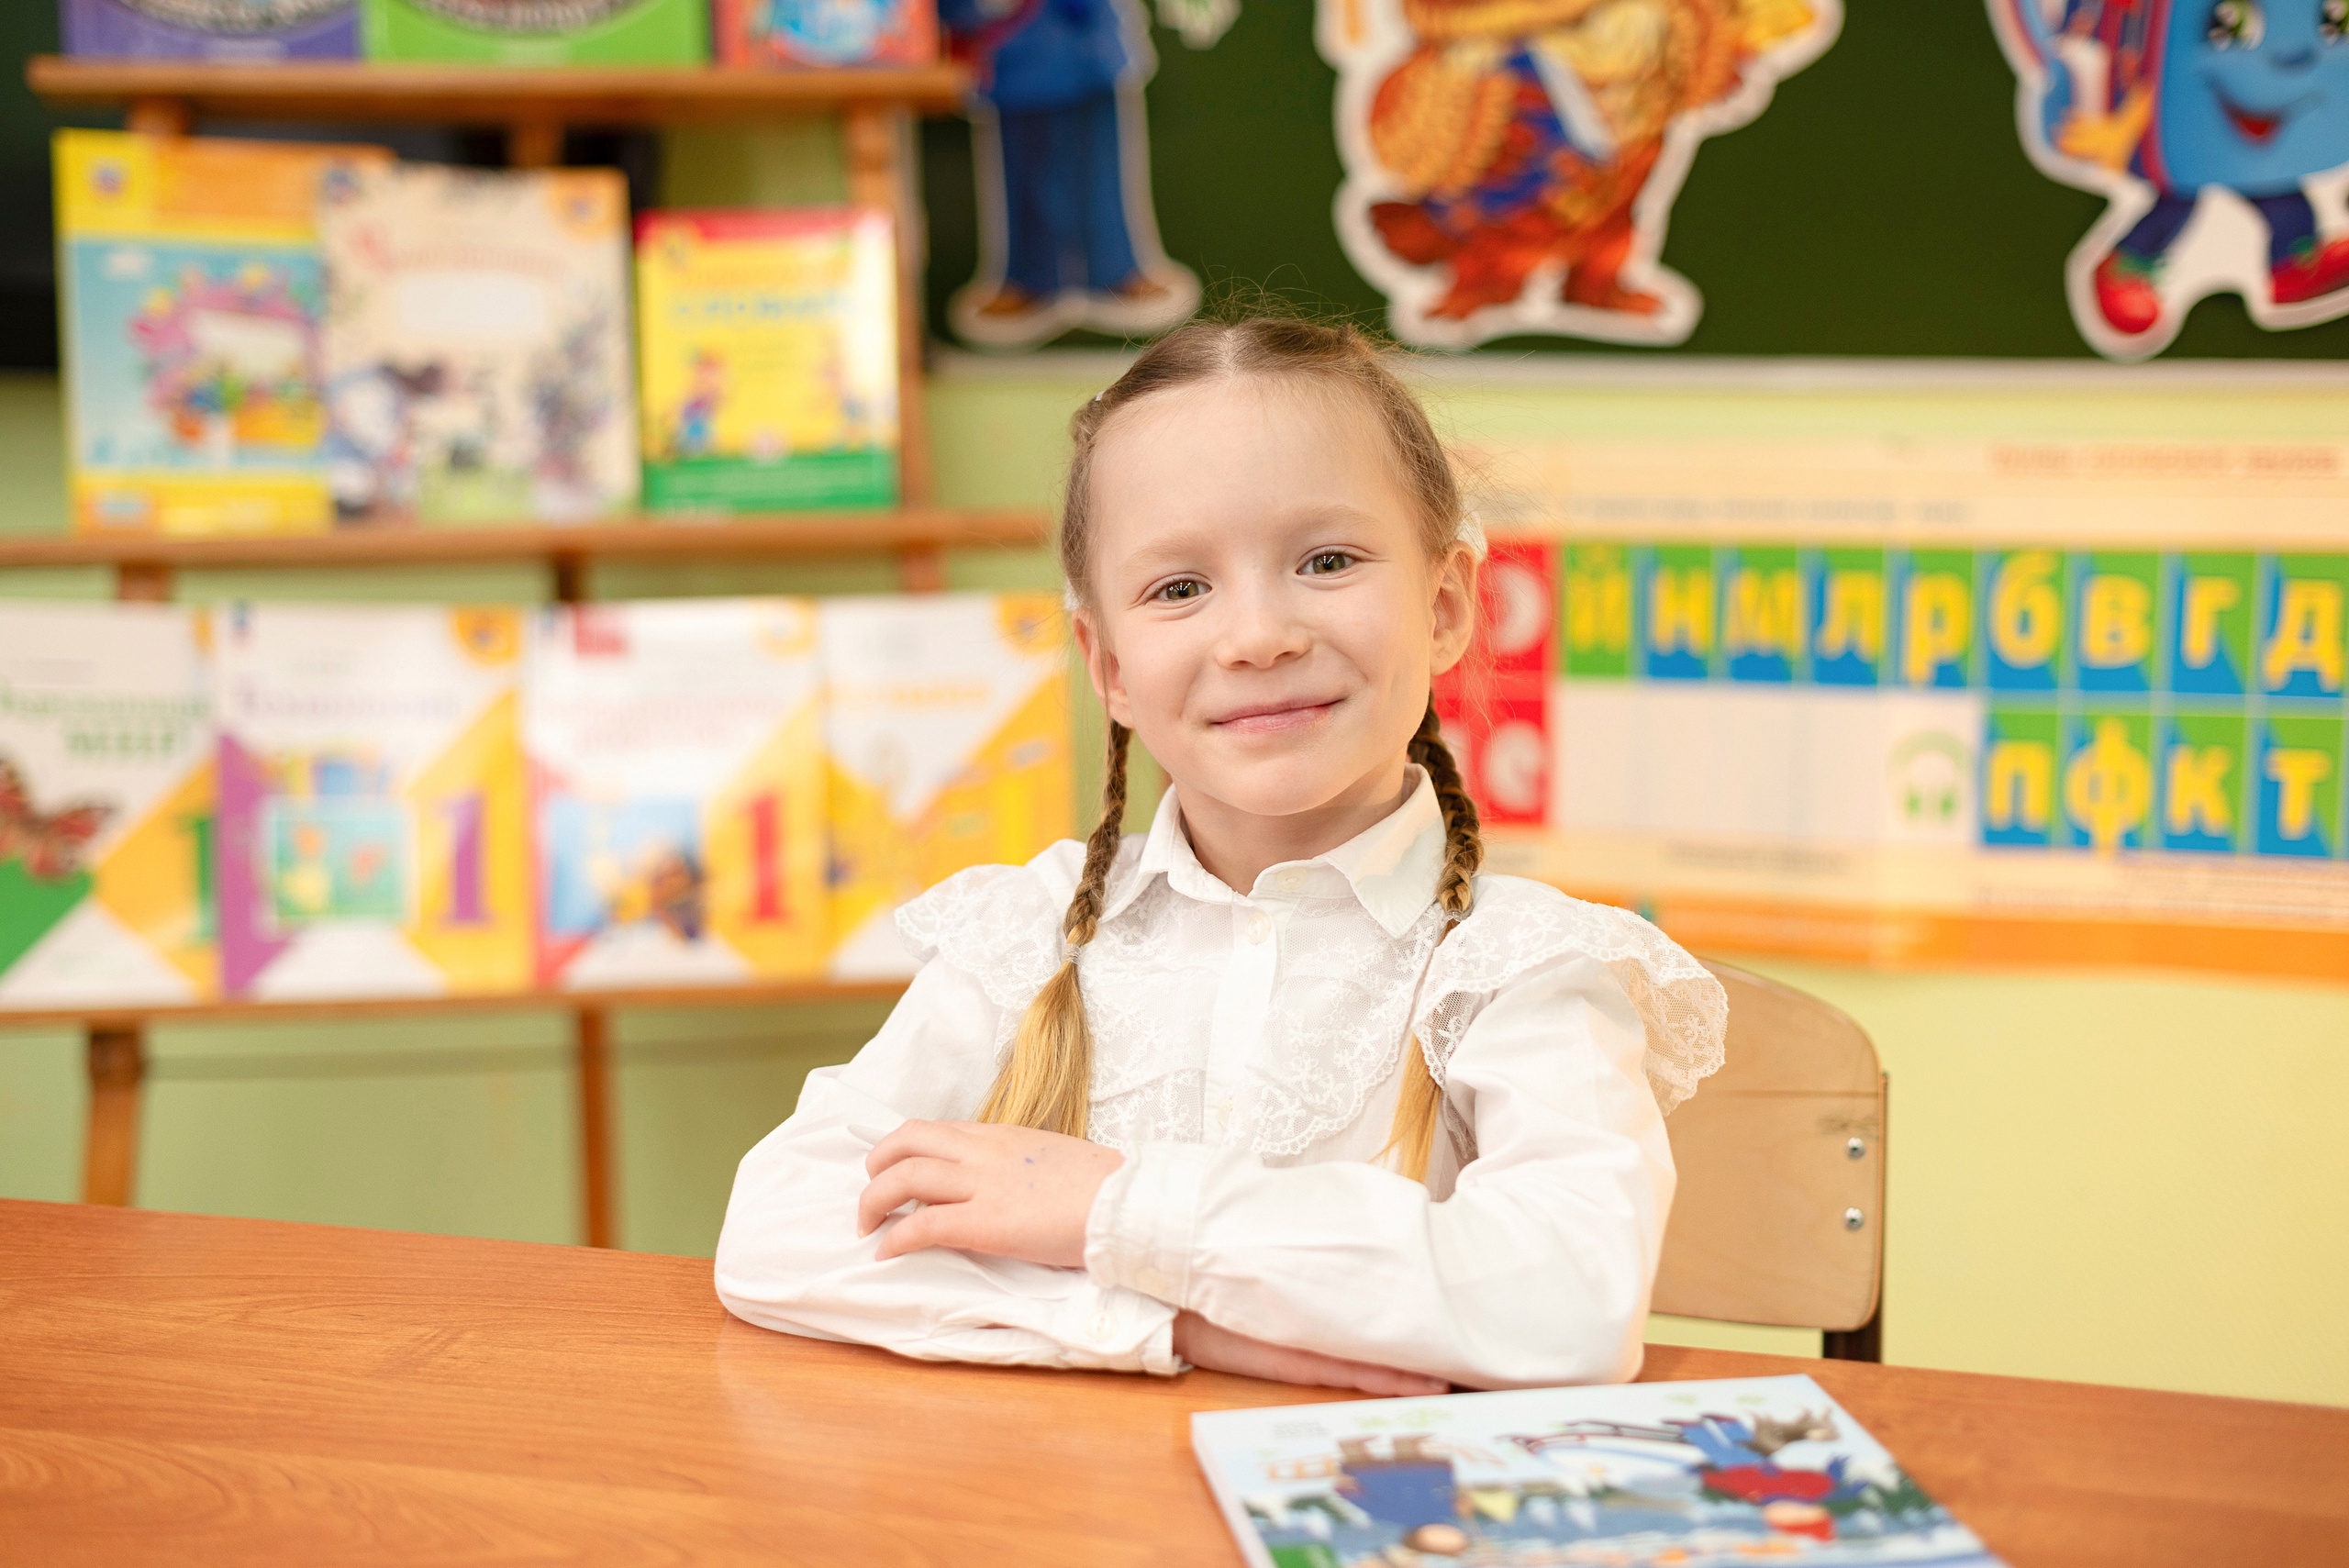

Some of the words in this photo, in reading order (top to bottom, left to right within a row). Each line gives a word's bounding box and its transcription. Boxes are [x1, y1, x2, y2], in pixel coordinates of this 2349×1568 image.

[1656, 569, 1712, 651] н
[1817, 571, 1883, 661] л
[1905, 572, 1969, 684] р
[1990, 550, 2061, 667] б
[2083, 574, 2152, 667] в
[2183, 576, 2239, 668] г
[2266, 578, 2345, 690] д
[738, 789, 795, 927] 1
[1988, 741, 2054, 830] п
[2066, 717, 2153, 860] ф
[2168, 746, 2232, 835] к
[2266, 750, 2331, 840] т
[440, 792, 501, 927] 1
